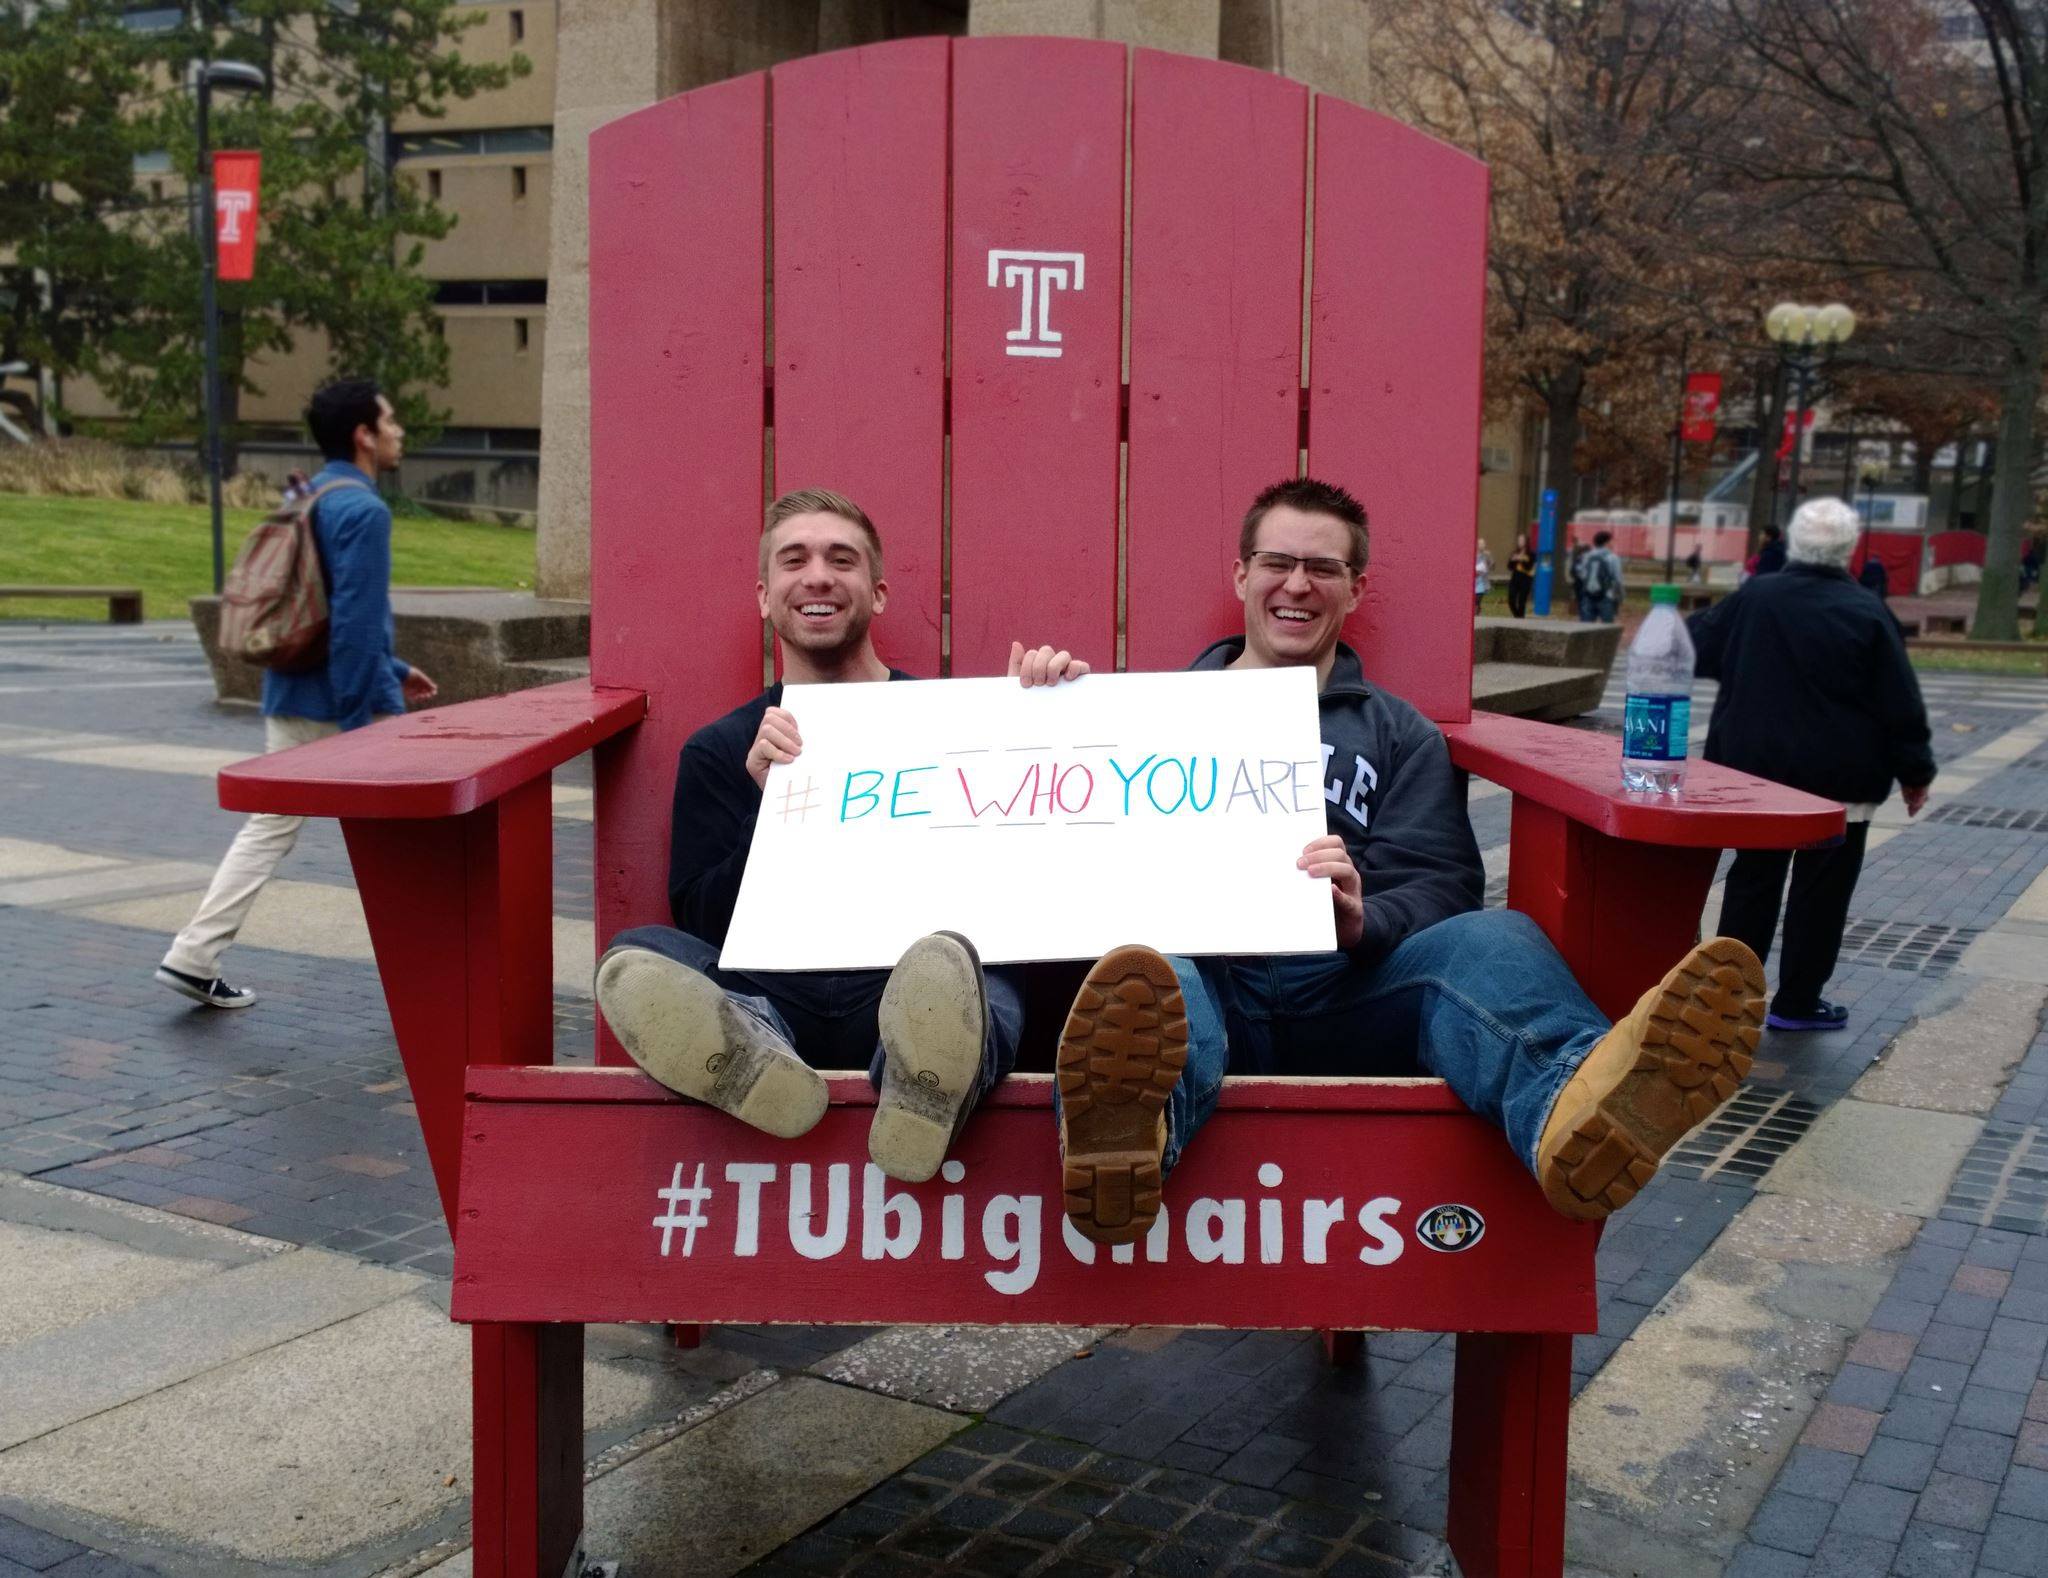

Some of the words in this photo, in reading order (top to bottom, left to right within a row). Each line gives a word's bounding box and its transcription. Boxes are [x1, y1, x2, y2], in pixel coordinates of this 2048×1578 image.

[216, 190, 252, 243] T
[987, 249, 1085, 357] T
[840, 765, 939, 823] BE
[956, 761, 1094, 818] WHO
[1108, 753, 1218, 816] YOU
[1225, 758, 1320, 814] ARE
